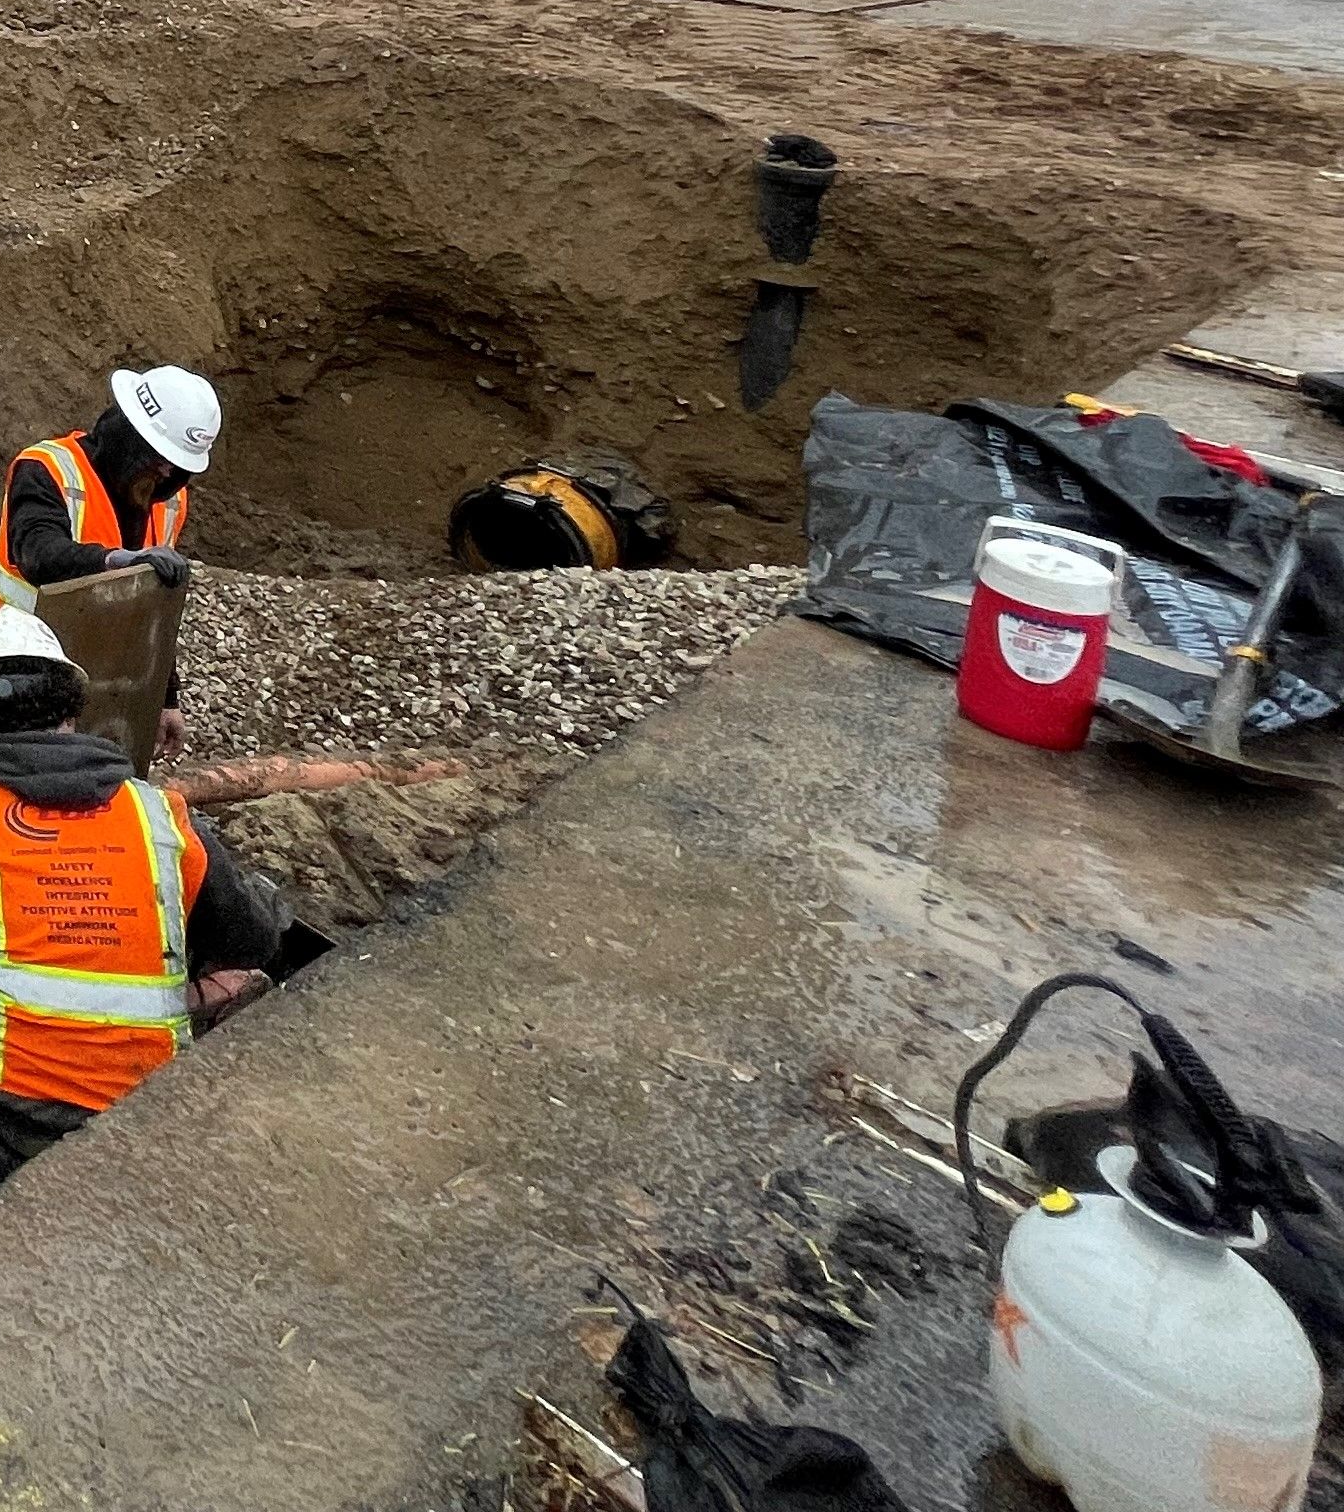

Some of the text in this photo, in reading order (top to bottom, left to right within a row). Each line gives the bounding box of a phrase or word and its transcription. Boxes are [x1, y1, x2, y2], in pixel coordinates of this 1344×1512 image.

[137, 383, 161, 417] YETI
[50, 862, 94, 871] SAFETY
[37, 876, 113, 886] EXCELLENCE
[45, 891, 110, 900] INTEGRITY
[21, 905, 138, 917] POSITIVE ATTITUDE
[48, 921, 118, 931] TEAMWORK
